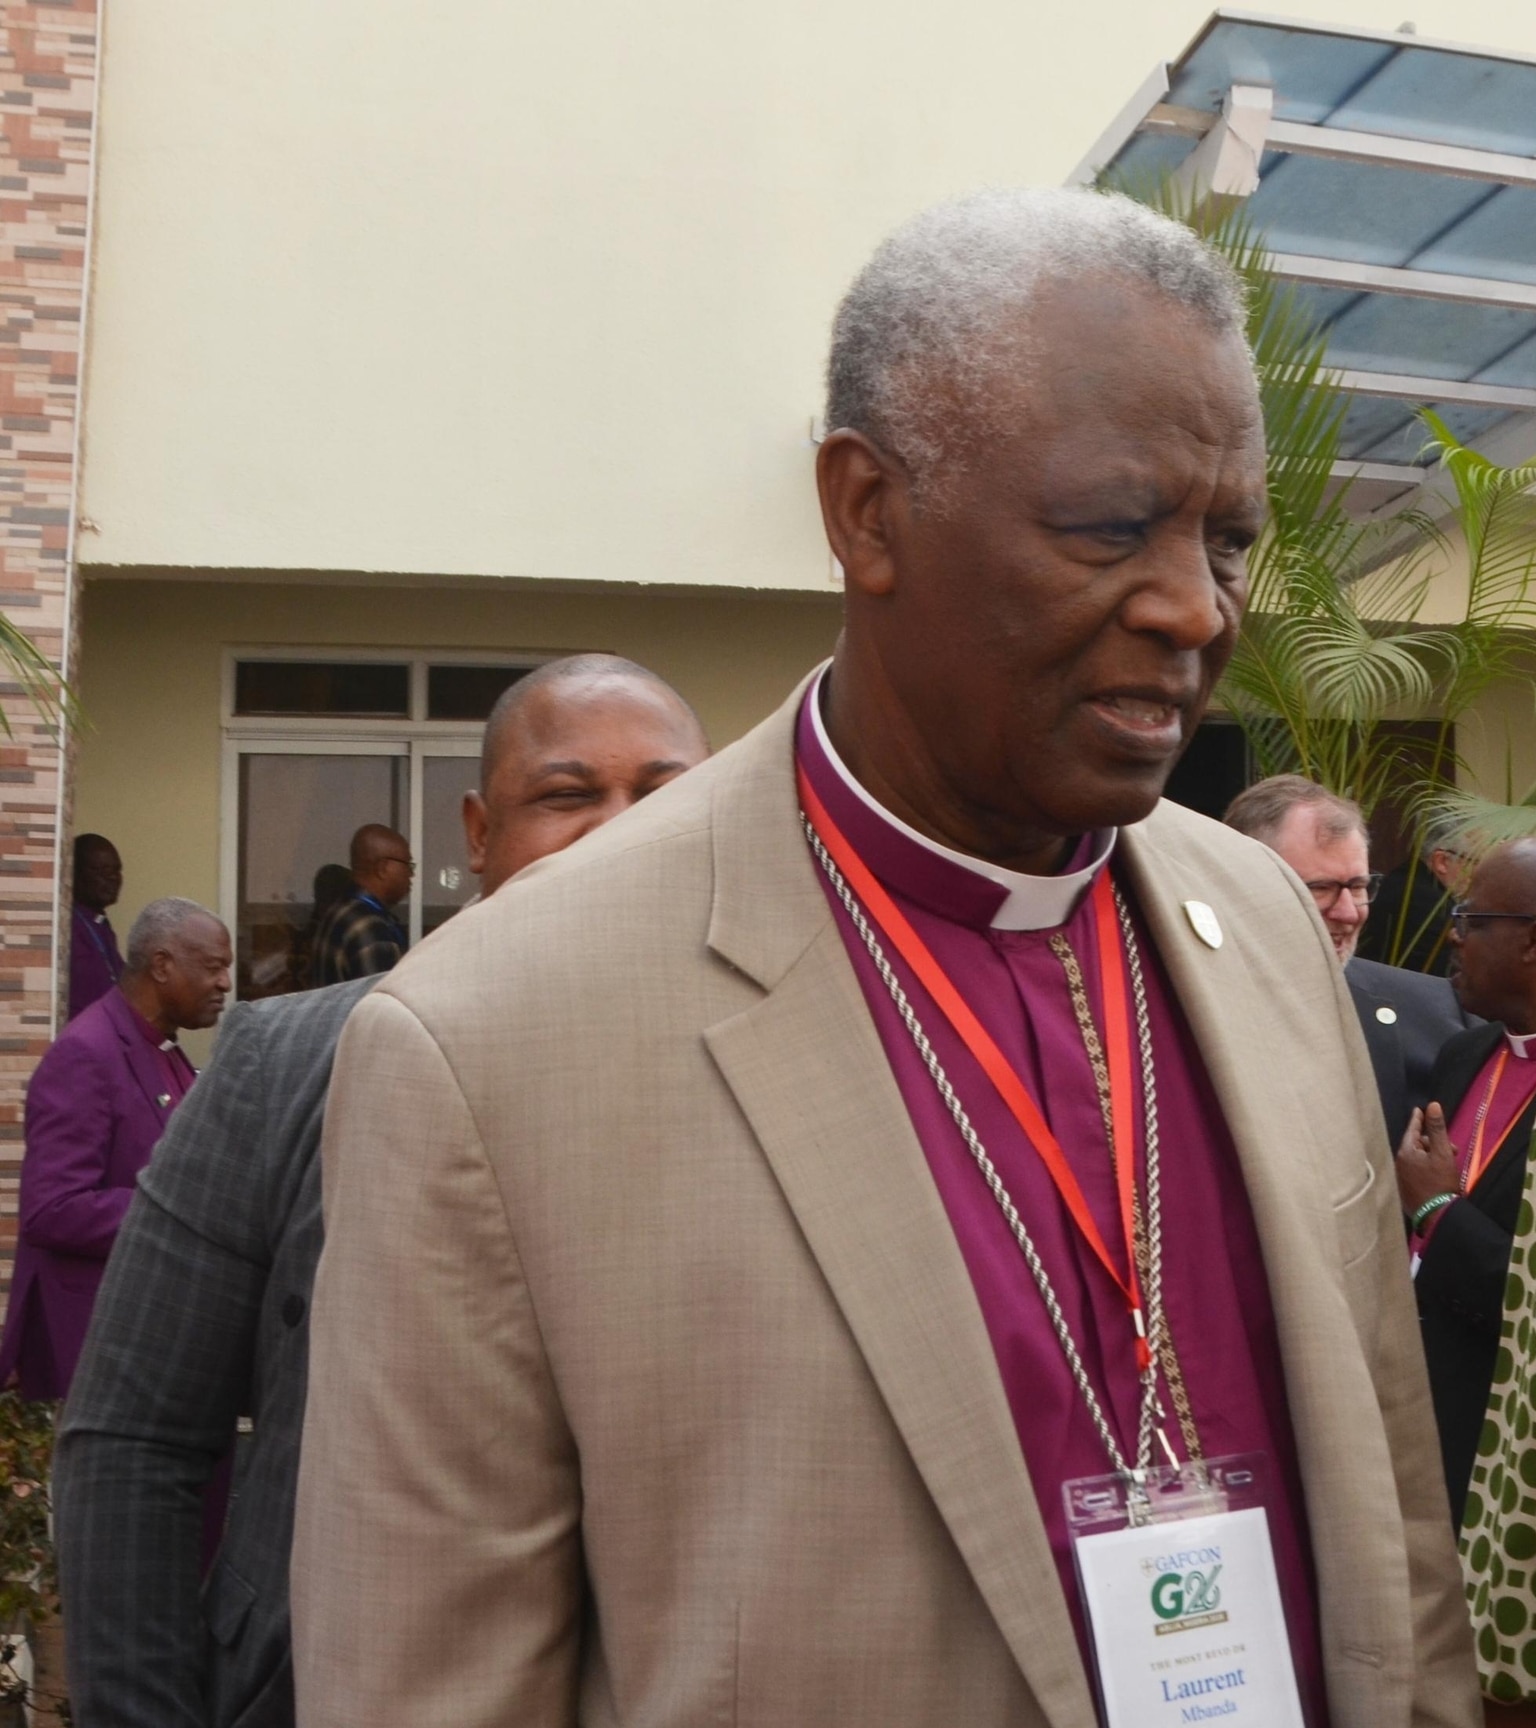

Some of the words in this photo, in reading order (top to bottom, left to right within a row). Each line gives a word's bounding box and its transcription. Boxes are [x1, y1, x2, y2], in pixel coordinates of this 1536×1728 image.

[1155, 1546, 1221, 1572] GAFCON
[1151, 1564, 1223, 1619] G26
[1160, 1668, 1245, 1702] Laurent
[1181, 1699, 1237, 1724] Mbanda
